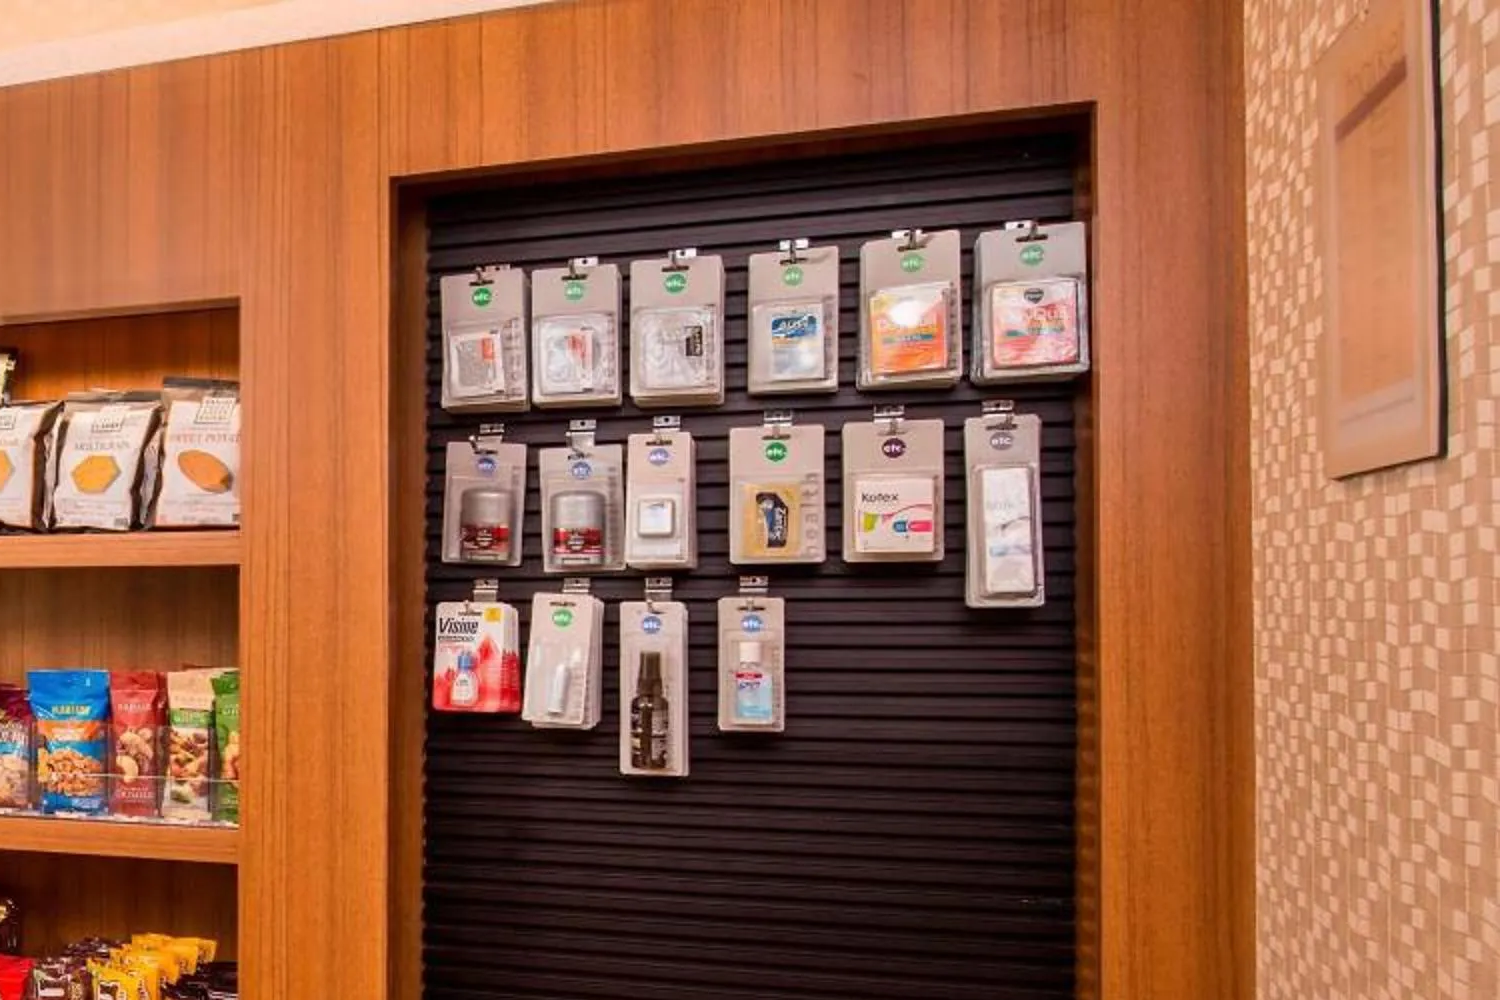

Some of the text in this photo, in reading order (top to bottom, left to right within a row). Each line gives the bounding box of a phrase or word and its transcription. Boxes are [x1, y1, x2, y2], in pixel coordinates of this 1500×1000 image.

[861, 492, 899, 503] Kotex
[800, 473, 820, 559] health
[439, 617, 479, 635] Visine
